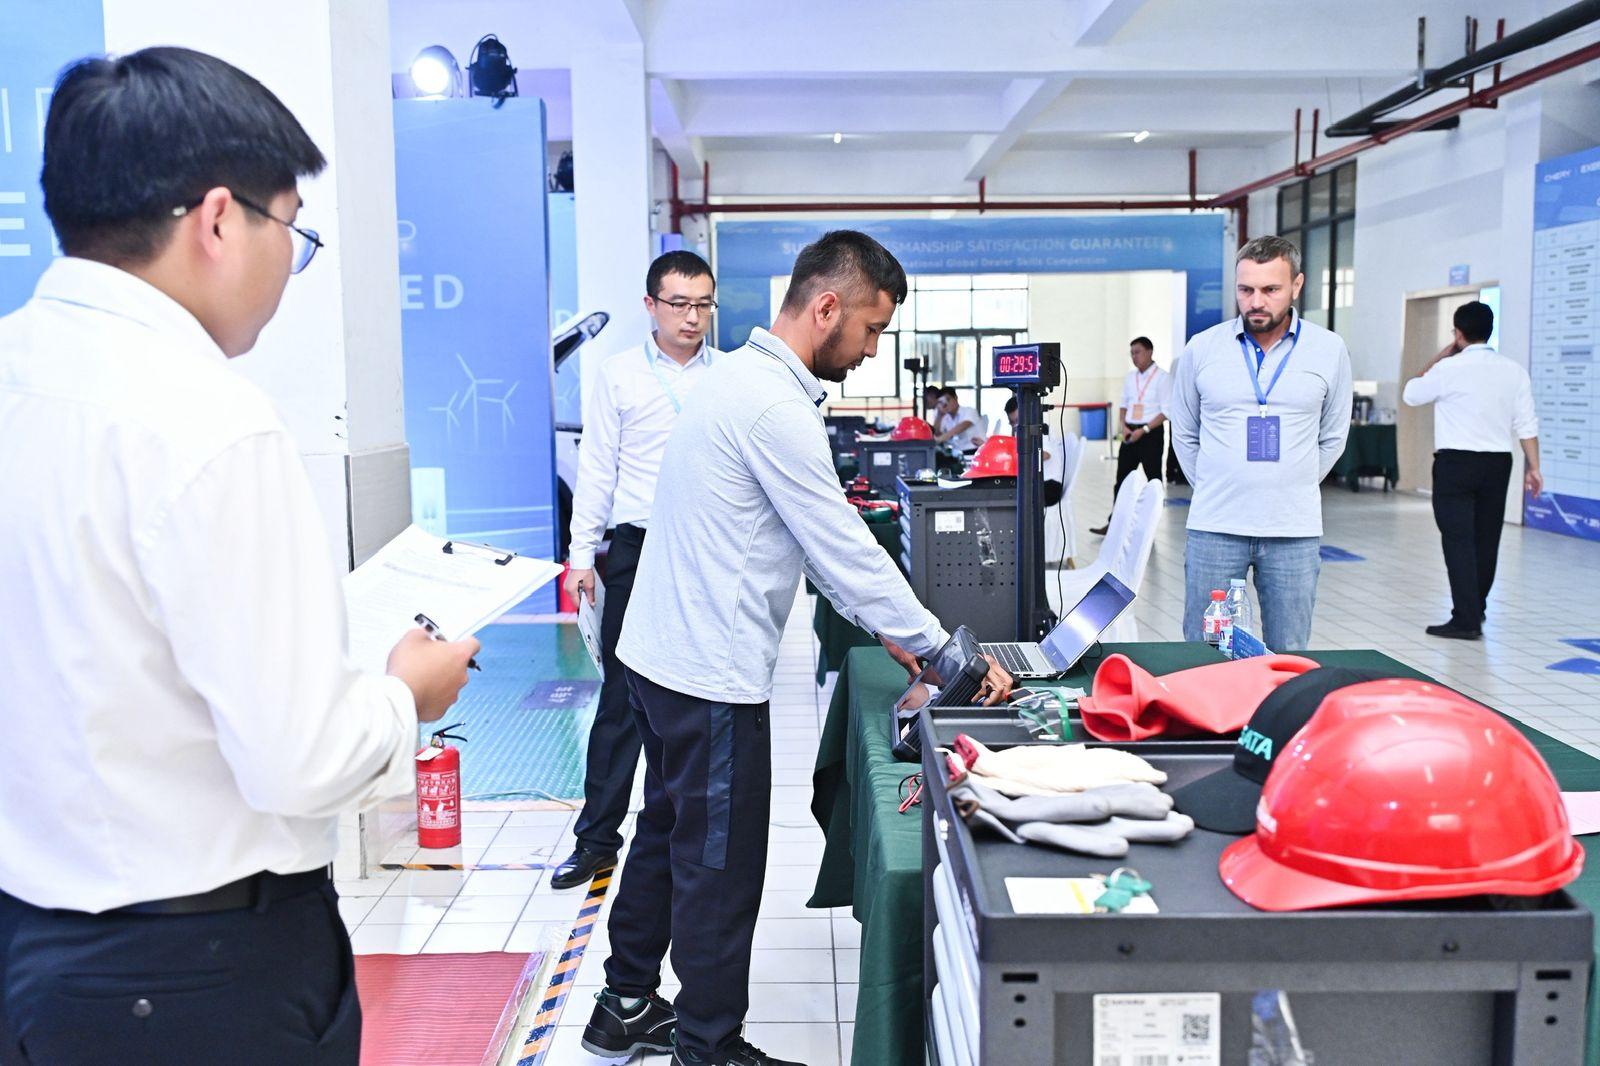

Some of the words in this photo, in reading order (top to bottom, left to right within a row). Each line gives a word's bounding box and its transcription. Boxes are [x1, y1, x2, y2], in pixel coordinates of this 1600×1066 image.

[967, 237, 1067, 251] SATISFACTION
[946, 258, 978, 269] Global
[981, 257, 1013, 267] Dealer
[1016, 256, 1043, 267] Skills
[399, 273, 464, 310] ED
